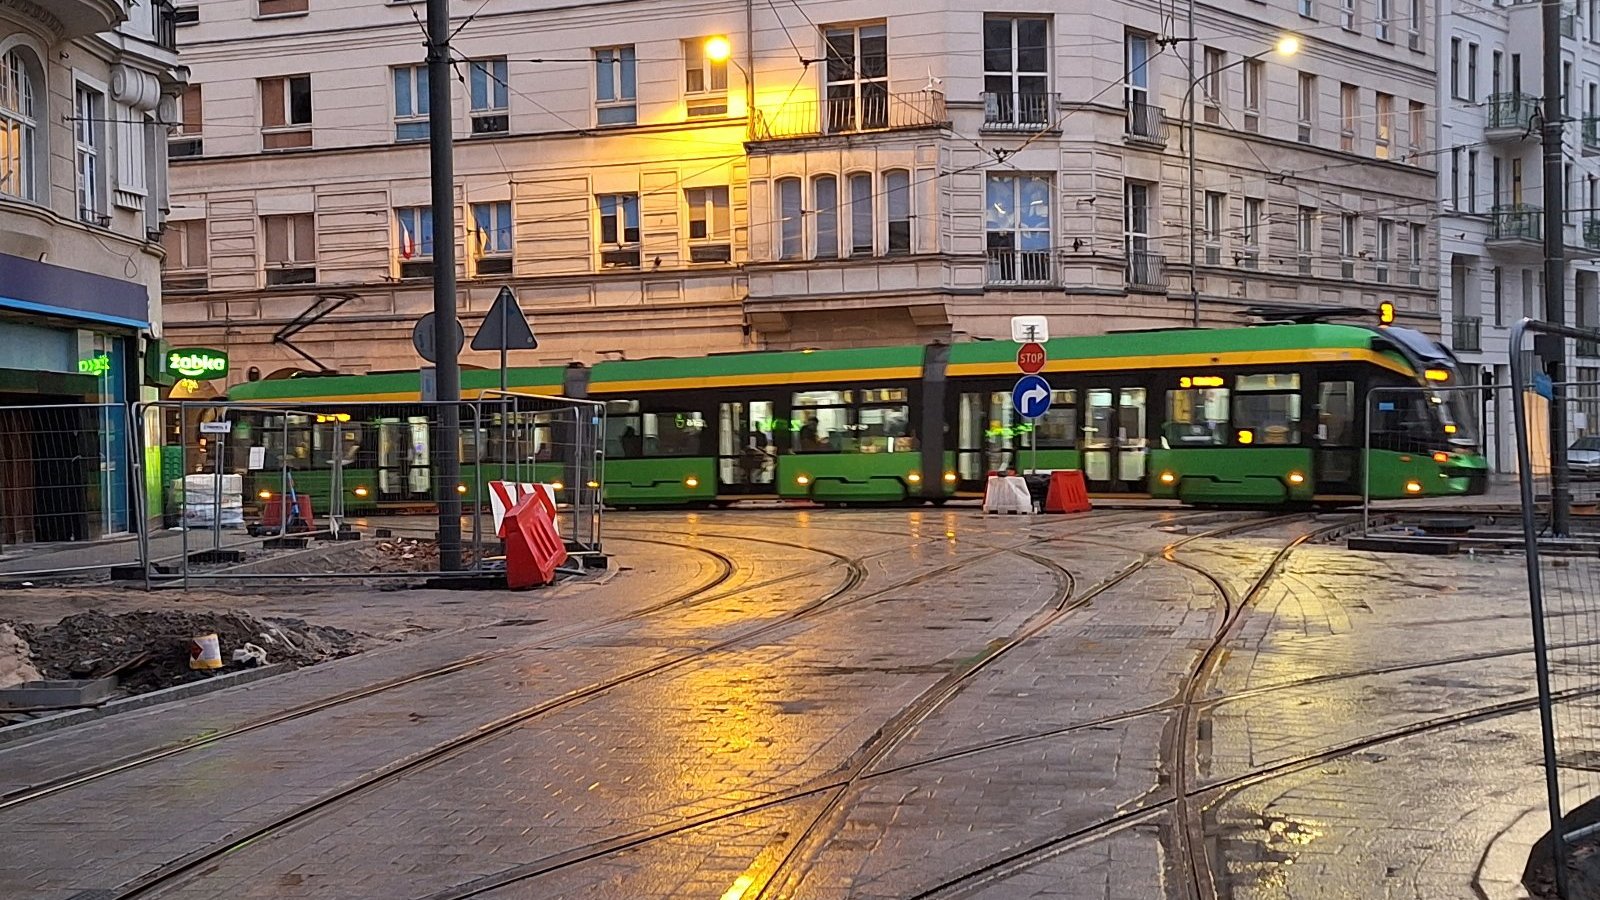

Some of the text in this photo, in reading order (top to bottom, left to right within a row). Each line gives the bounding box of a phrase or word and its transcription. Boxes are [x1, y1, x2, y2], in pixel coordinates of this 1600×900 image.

[1381, 303, 1393, 323] 3
[170, 353, 225, 371] żabka
[1020, 353, 1043, 364] STOP
[1238, 430, 1253, 444] 3
